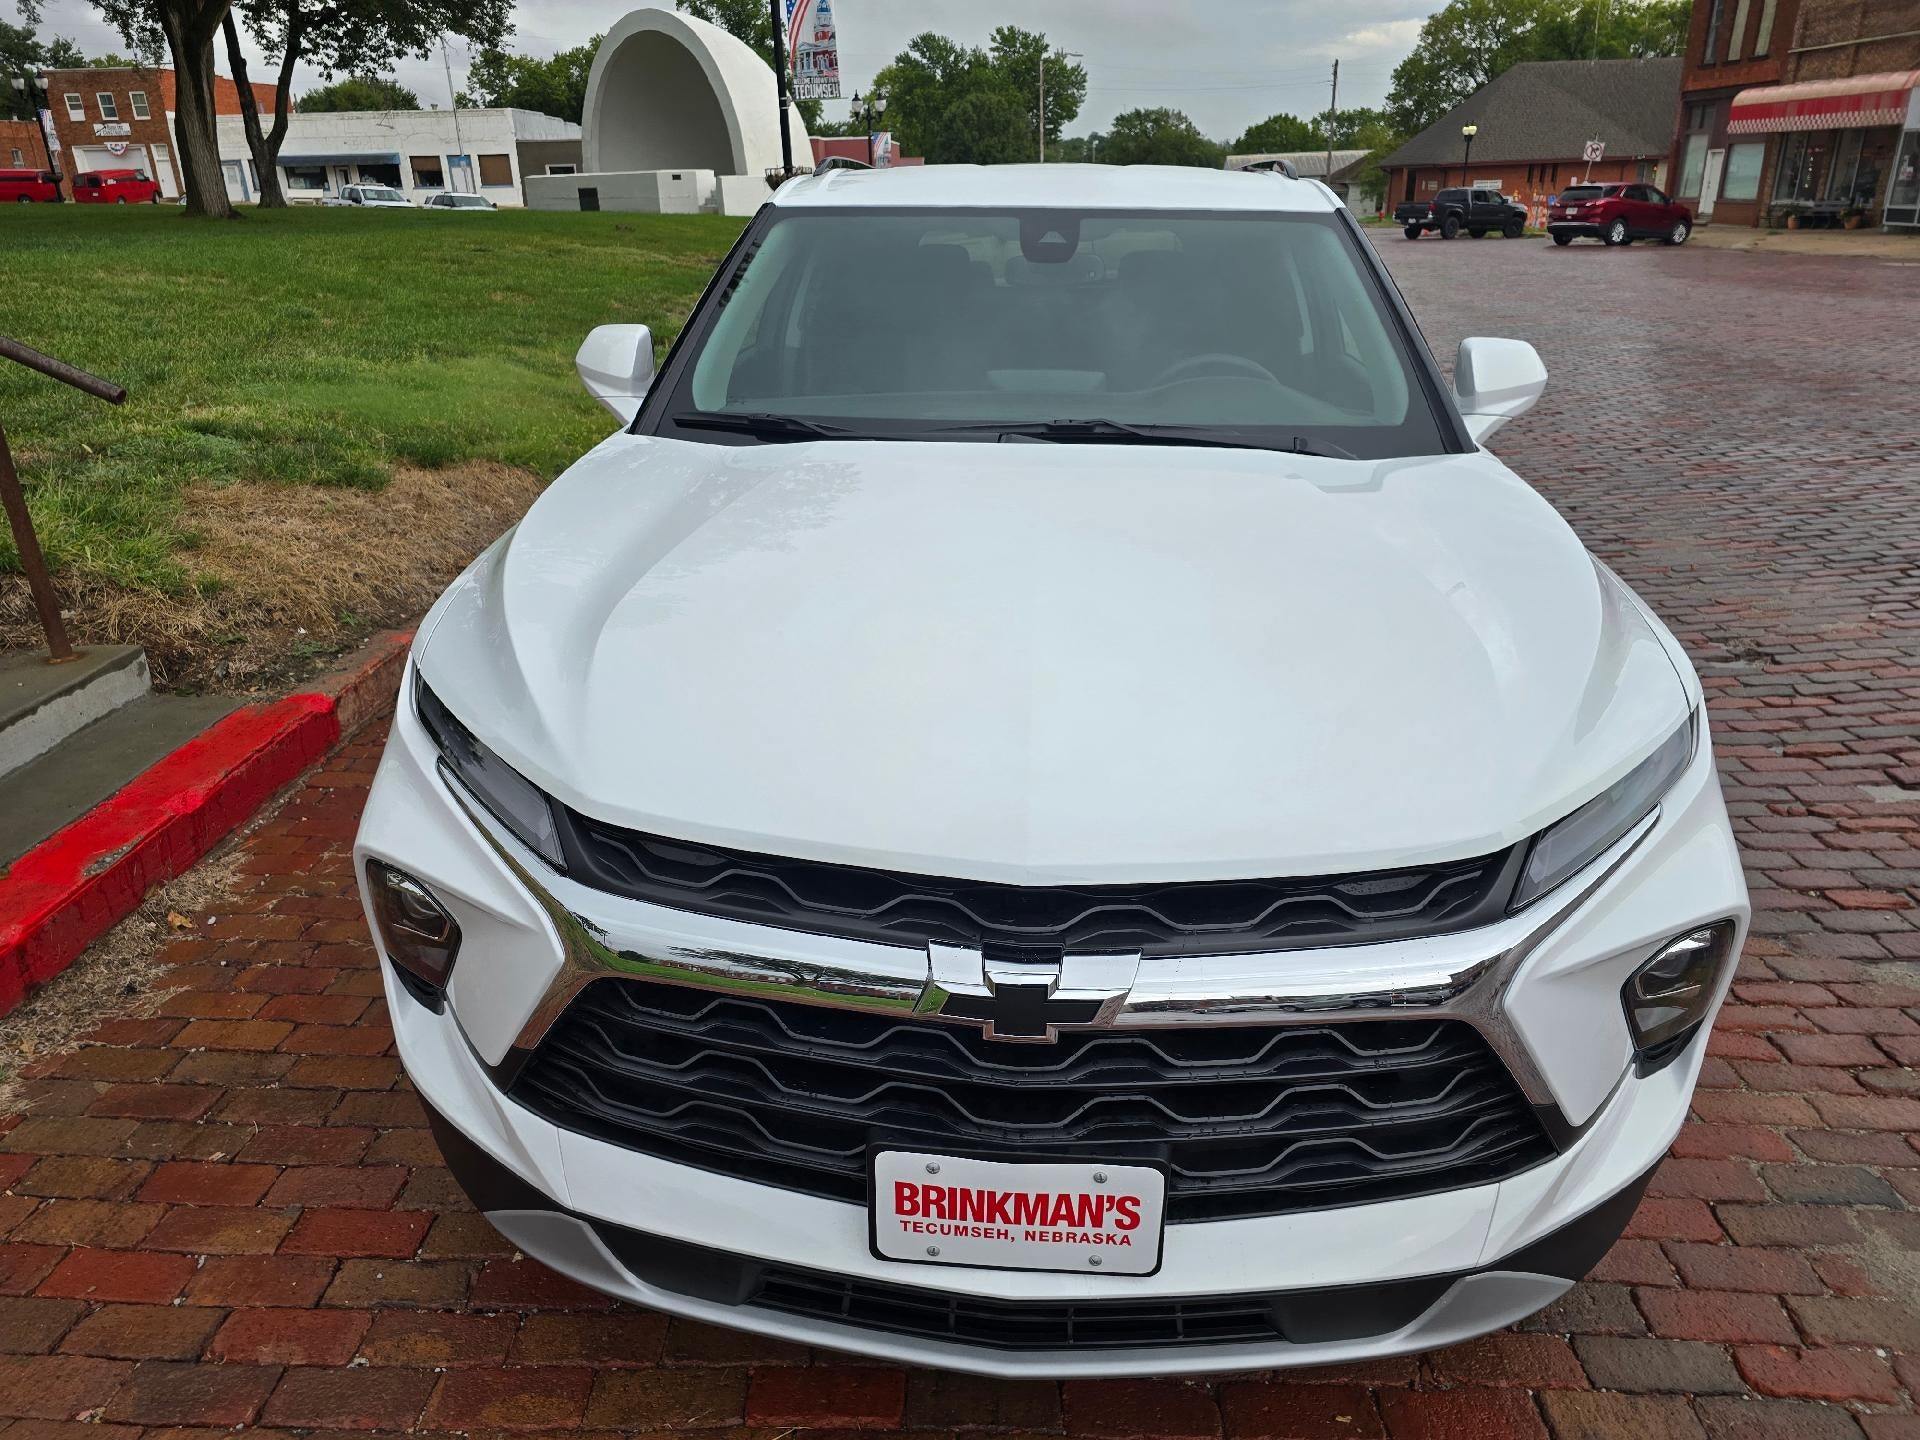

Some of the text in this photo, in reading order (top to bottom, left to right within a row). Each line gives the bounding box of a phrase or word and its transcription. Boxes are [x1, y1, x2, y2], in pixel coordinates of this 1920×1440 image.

[793, 83, 840, 99] TECUMSEH
[894, 1181, 1141, 1230] BRINKMAN'S
[900, 1220, 1132, 1246] TECUMSEH, NEBRASKA
